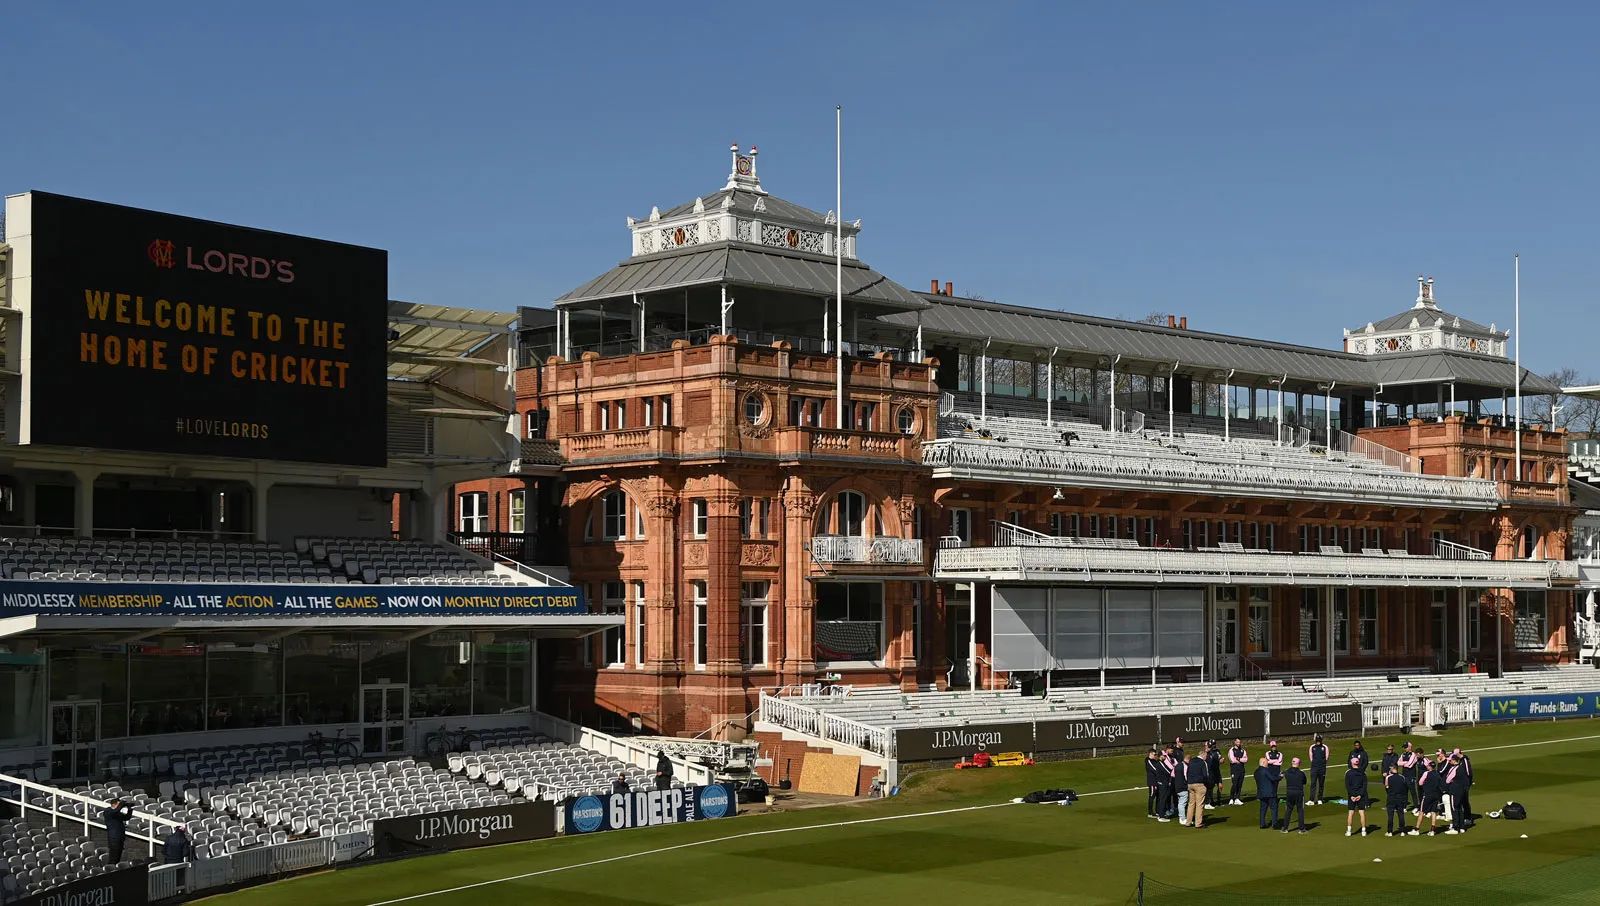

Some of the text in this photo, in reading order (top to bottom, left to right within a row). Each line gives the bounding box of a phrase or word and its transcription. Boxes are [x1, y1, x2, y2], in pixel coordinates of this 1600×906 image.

[186, 246, 295, 283] LORD'S
[85, 289, 345, 350] WELCOME TO THE
[80, 332, 350, 389] HOME OF CRICKET
[176, 417, 269, 439] #LOVELORDS
[3, 593, 76, 608] MIDDLESEX
[79, 594, 163, 608] MEMBERSHIP
[173, 595, 197, 608] ALL
[197, 595, 223, 608] THE
[225, 595, 273, 608] ACTION
[284, 596, 307, 609] ALL
[309, 596, 333, 609] THE
[335, 596, 379, 609] GAMES
[388, 595, 419, 608] NOW
[421, 595, 442, 608] ON
[444, 596, 501, 608] MONTHLY
[503, 595, 544, 608] DIRECT
[547, 595, 578, 607] DEBIT
[1185, 716, 1242, 735] J.P.Morgan
[1292, 705, 1342, 726] J.P.Morgan
[931, 729, 1002, 751] J.P.Morgan
[1066, 722, 1130, 742] J.P.Morgan
[609, 789, 682, 830] 61 DEEP
[685, 786, 695, 822] PALE ALE
[415, 813, 513, 840] J.P.Morgan
[40, 886, 116, 906] Morgan
